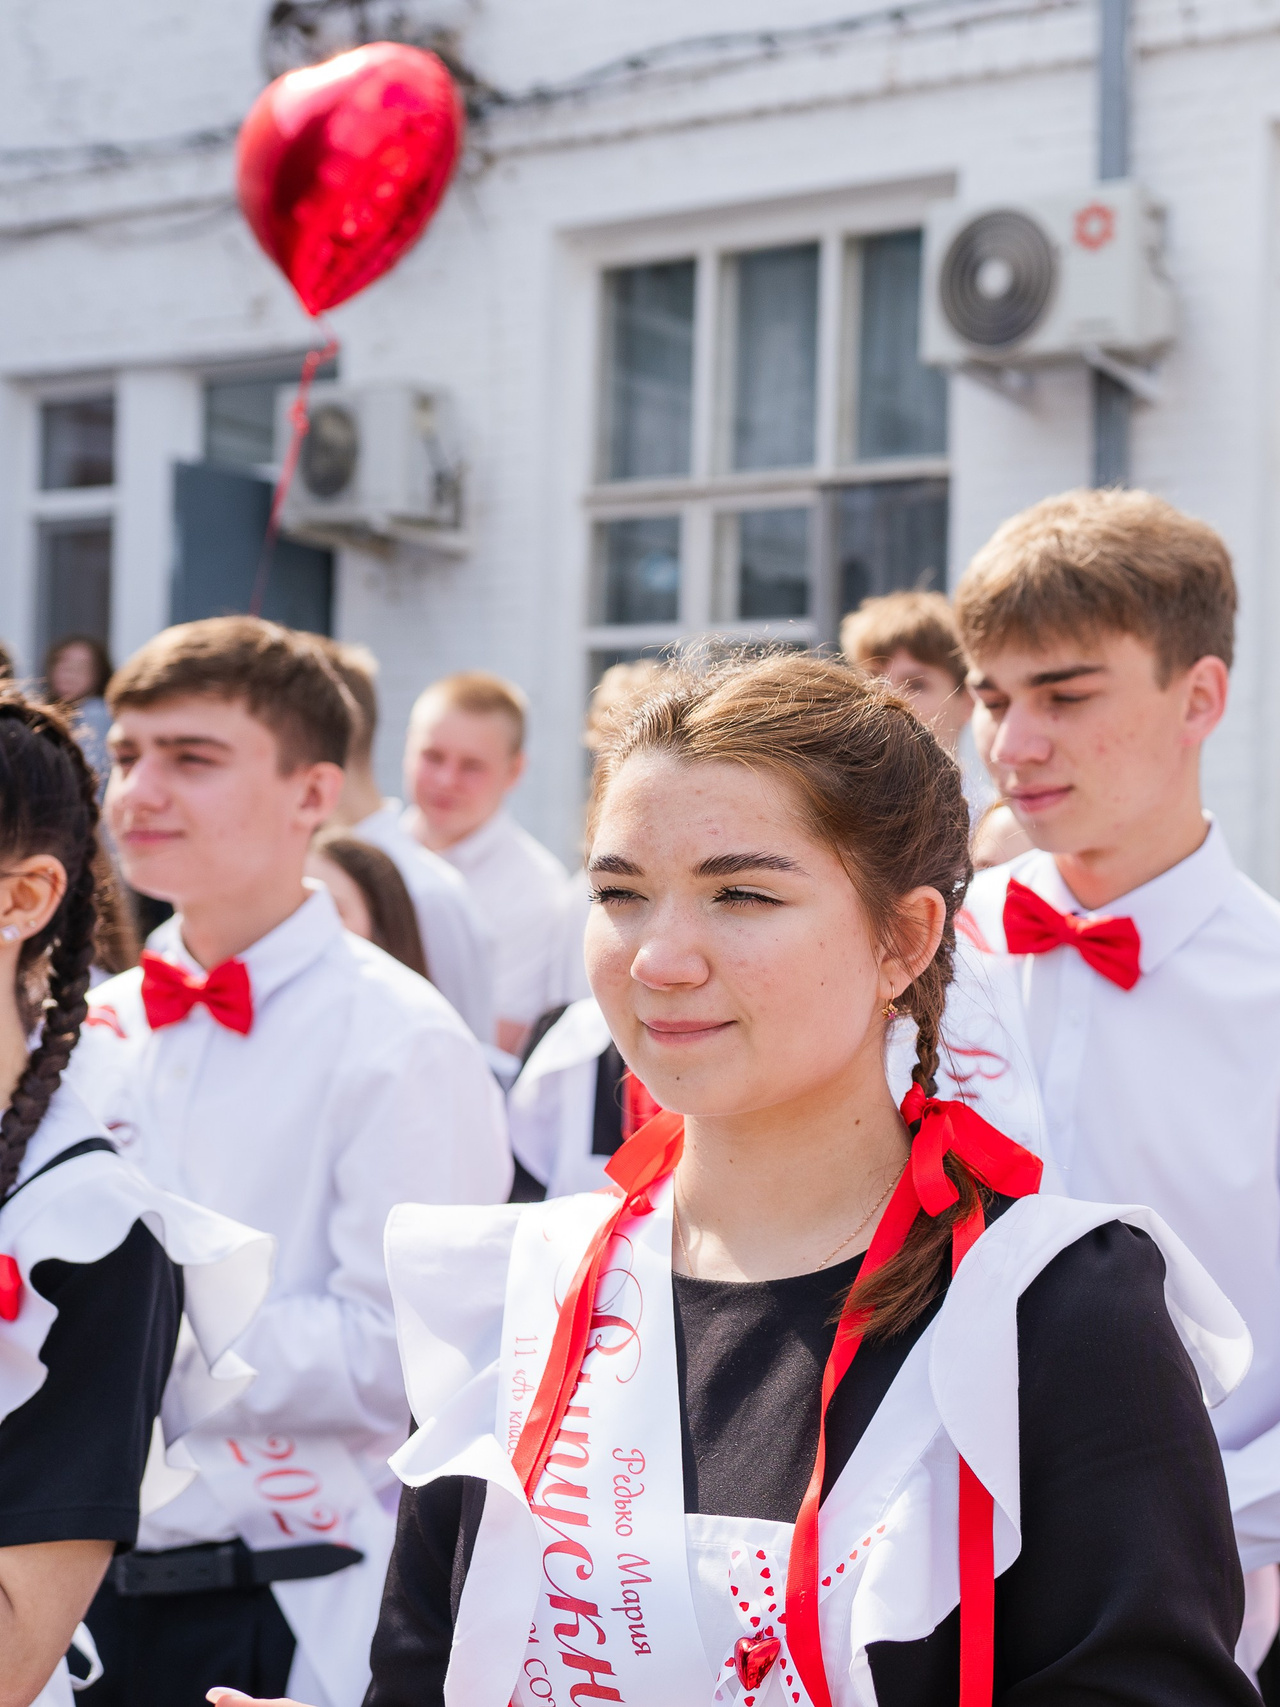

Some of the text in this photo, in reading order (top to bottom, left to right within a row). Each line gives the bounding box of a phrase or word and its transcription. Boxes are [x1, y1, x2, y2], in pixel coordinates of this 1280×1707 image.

[514, 1335, 538, 1357] 11
[511, 1368, 536, 1401] «А»
[226, 1432, 352, 1549] 202
[610, 1447, 653, 1656] Редько Мария
